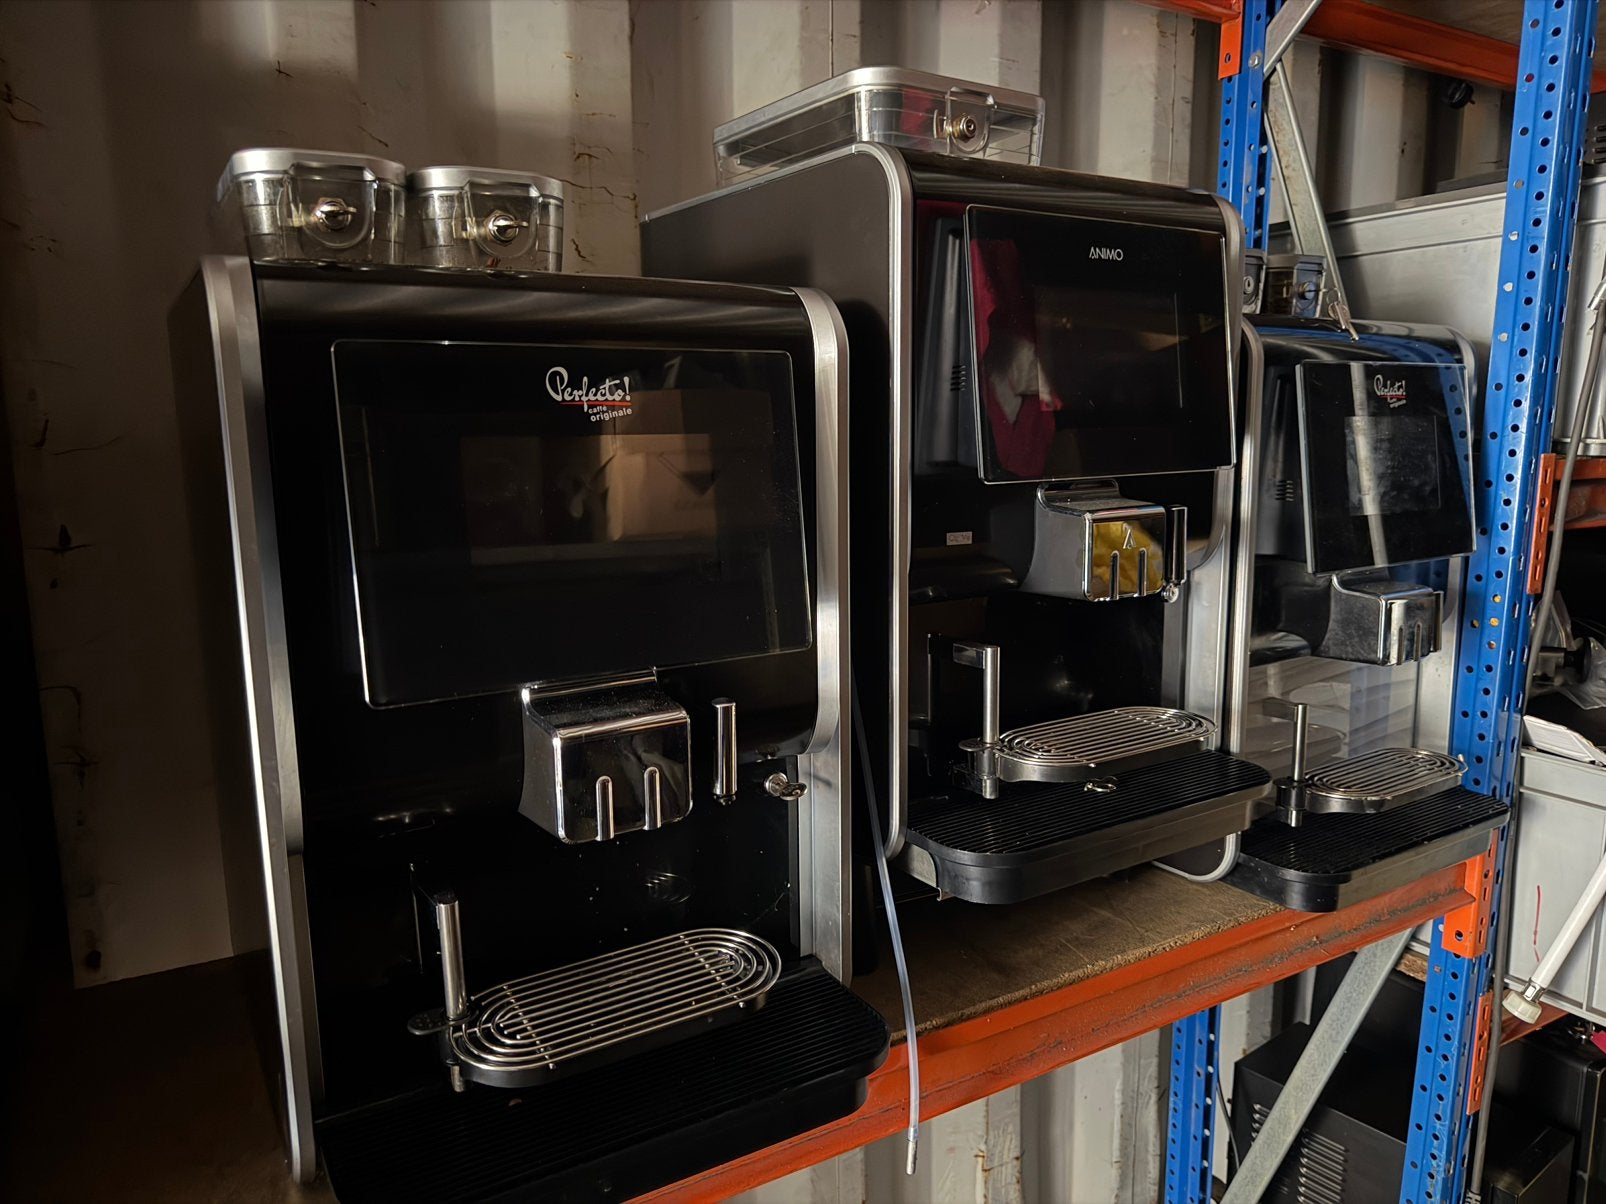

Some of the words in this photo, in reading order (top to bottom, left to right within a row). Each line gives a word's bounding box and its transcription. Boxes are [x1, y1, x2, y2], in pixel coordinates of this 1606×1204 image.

[1089, 246, 1124, 261] ANIMO
[545, 366, 631, 413] Perfecto!
[590, 407, 633, 422] originale
